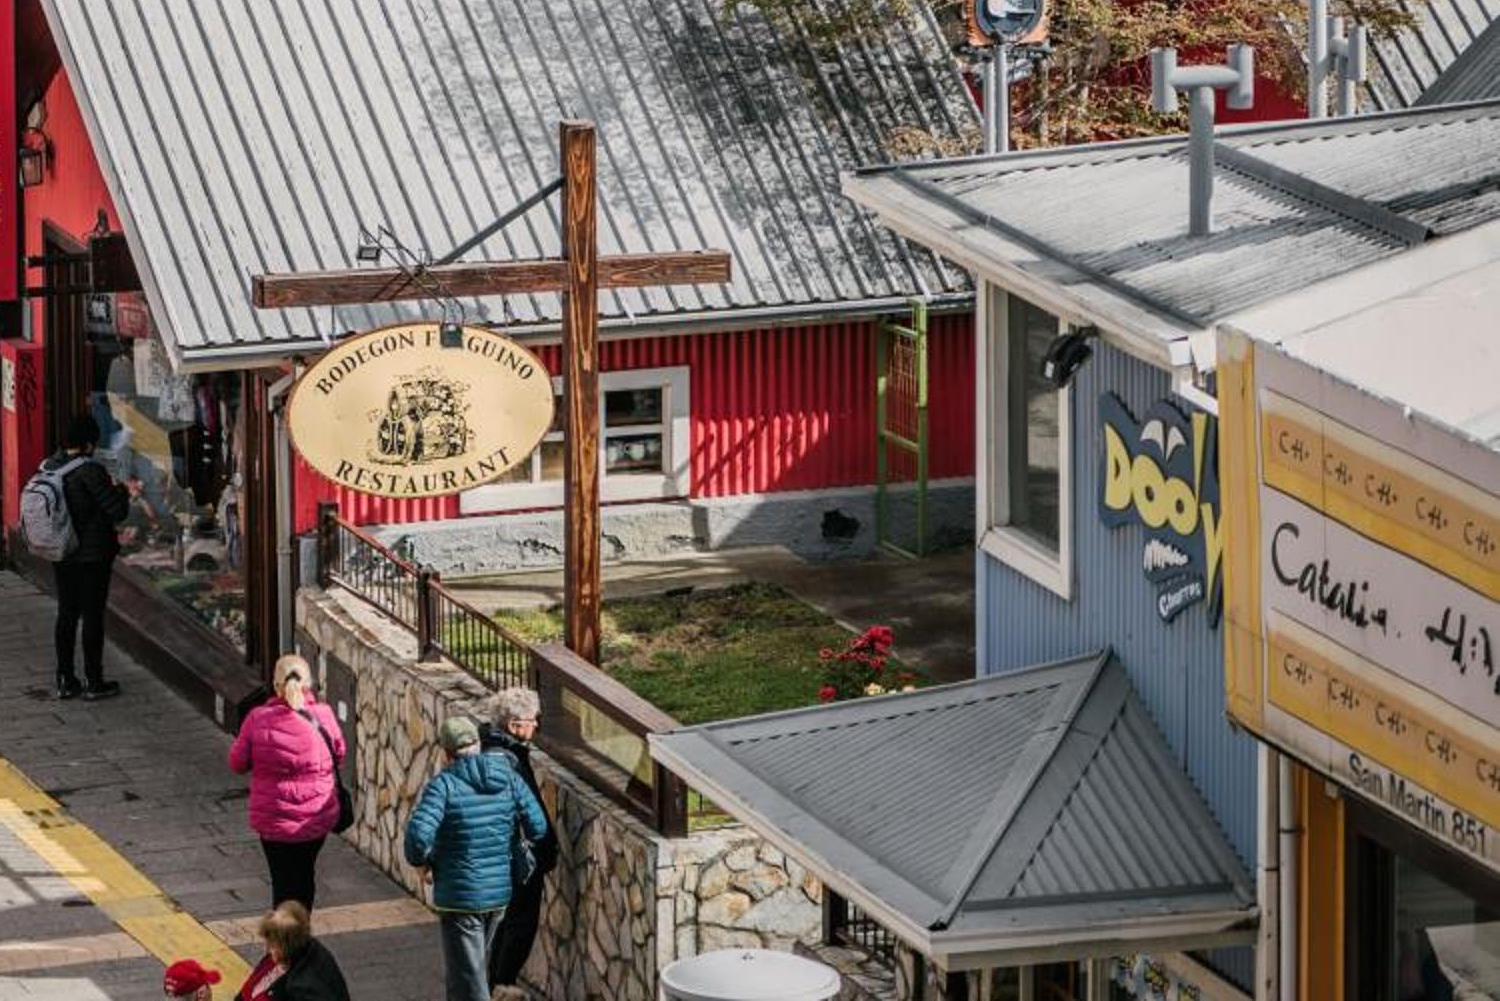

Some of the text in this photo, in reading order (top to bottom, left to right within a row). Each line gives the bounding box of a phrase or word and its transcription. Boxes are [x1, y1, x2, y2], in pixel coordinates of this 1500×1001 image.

[424, 330, 534, 381] FGUINO
[334, 446, 512, 495] RESTAURANT
[1349, 752, 1383, 792] San
[1452, 809, 1487, 857] 851
